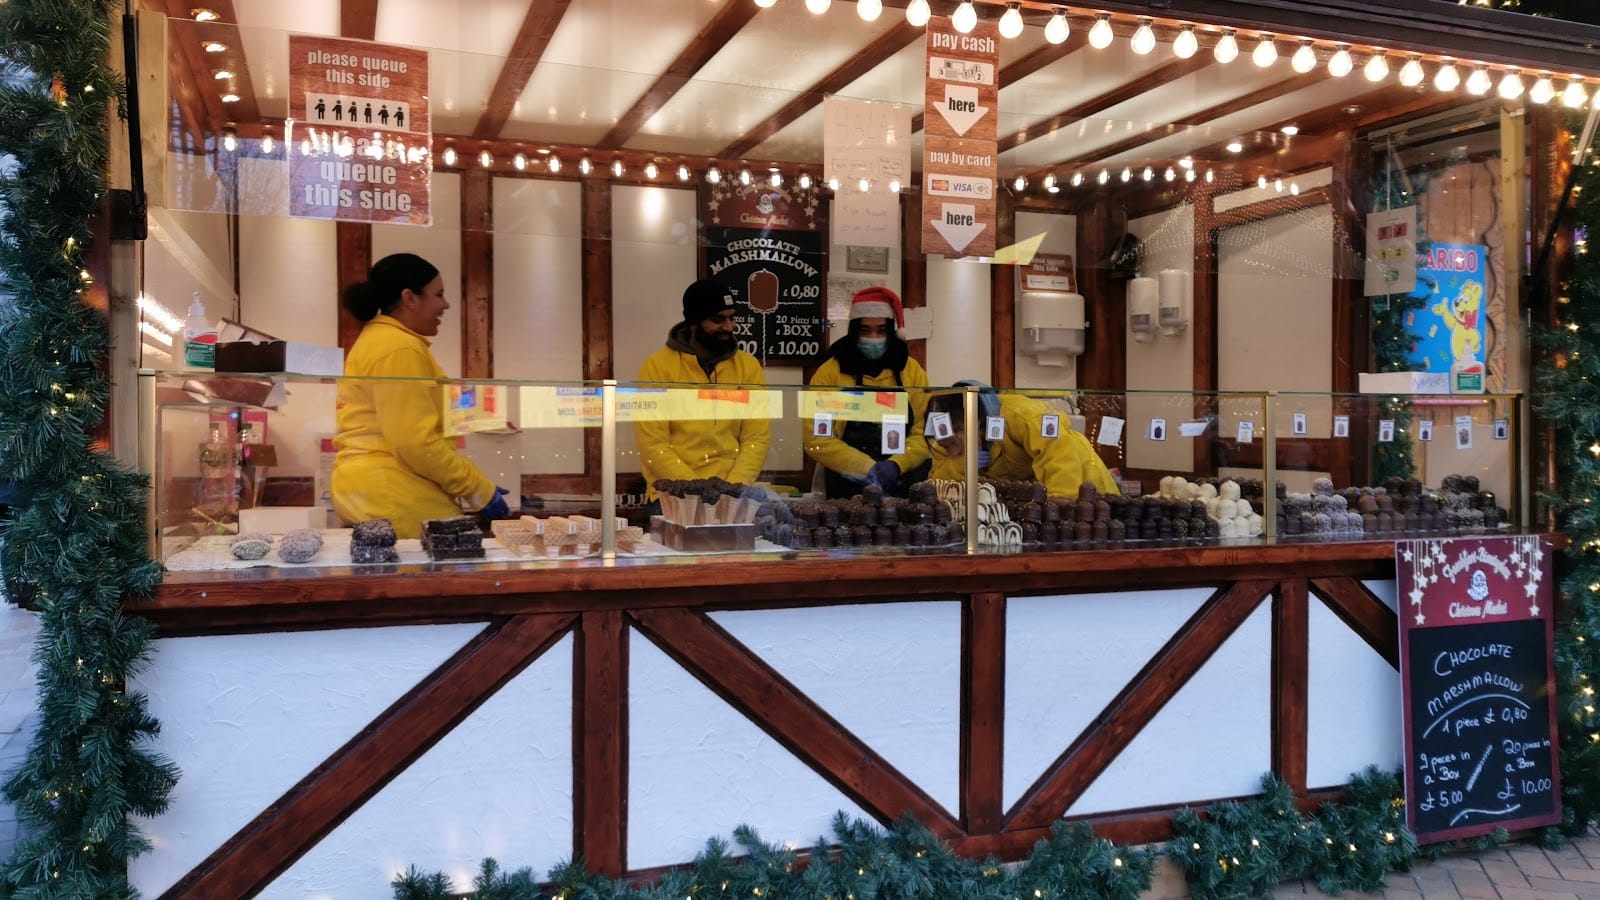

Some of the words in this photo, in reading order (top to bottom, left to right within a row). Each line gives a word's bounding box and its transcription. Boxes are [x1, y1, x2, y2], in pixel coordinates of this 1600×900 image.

[932, 32, 958, 50] pay
[961, 36, 995, 53] cash
[307, 50, 358, 67] please
[362, 57, 408, 74] queue
[326, 69, 355, 84] this
[358, 72, 390, 89] side
[948, 97, 975, 113] here
[930, 151, 949, 164] pay
[952, 151, 964, 166] by
[967, 155, 991, 167] card
[320, 160, 397, 185] queue
[953, 183, 972, 193] VISA
[304, 183, 353, 208] this
[360, 187, 412, 213] side
[946, 211, 973, 227] here
[727, 238, 801, 256] CHOCOLATE
[710, 250, 819, 278] MARSHMALLOW
[1416, 247, 1478, 273] ARIBO
[791, 285, 820, 299] 0,80
[747, 314, 755, 323] in
[776, 315, 788, 324] 20
[790, 316, 810, 325] Pieces
[812, 315, 820, 325] in
[733, 324, 752, 336] OX
[783, 324, 812, 337] BOX
[778, 340, 819, 356] 10.00
[1434, 644, 1513, 676] CHOCOLATE
[1427, 672, 1524, 716] MARSHMALLOW
[1442, 720, 1449, 733] 1
[1455, 717, 1480, 736] piece
[1502, 707, 1528, 724] 0,80
[1502, 739, 1521, 754] 20
[1541, 737, 1551, 747] in
[1461, 751, 1470, 760] in
[1505, 764, 1515, 772] a
[1516, 757, 1535, 769] Box
[1424, 775, 1435, 784] a
[1438, 766, 1460, 780] Box
[1521, 778, 1552, 794] 10.00
